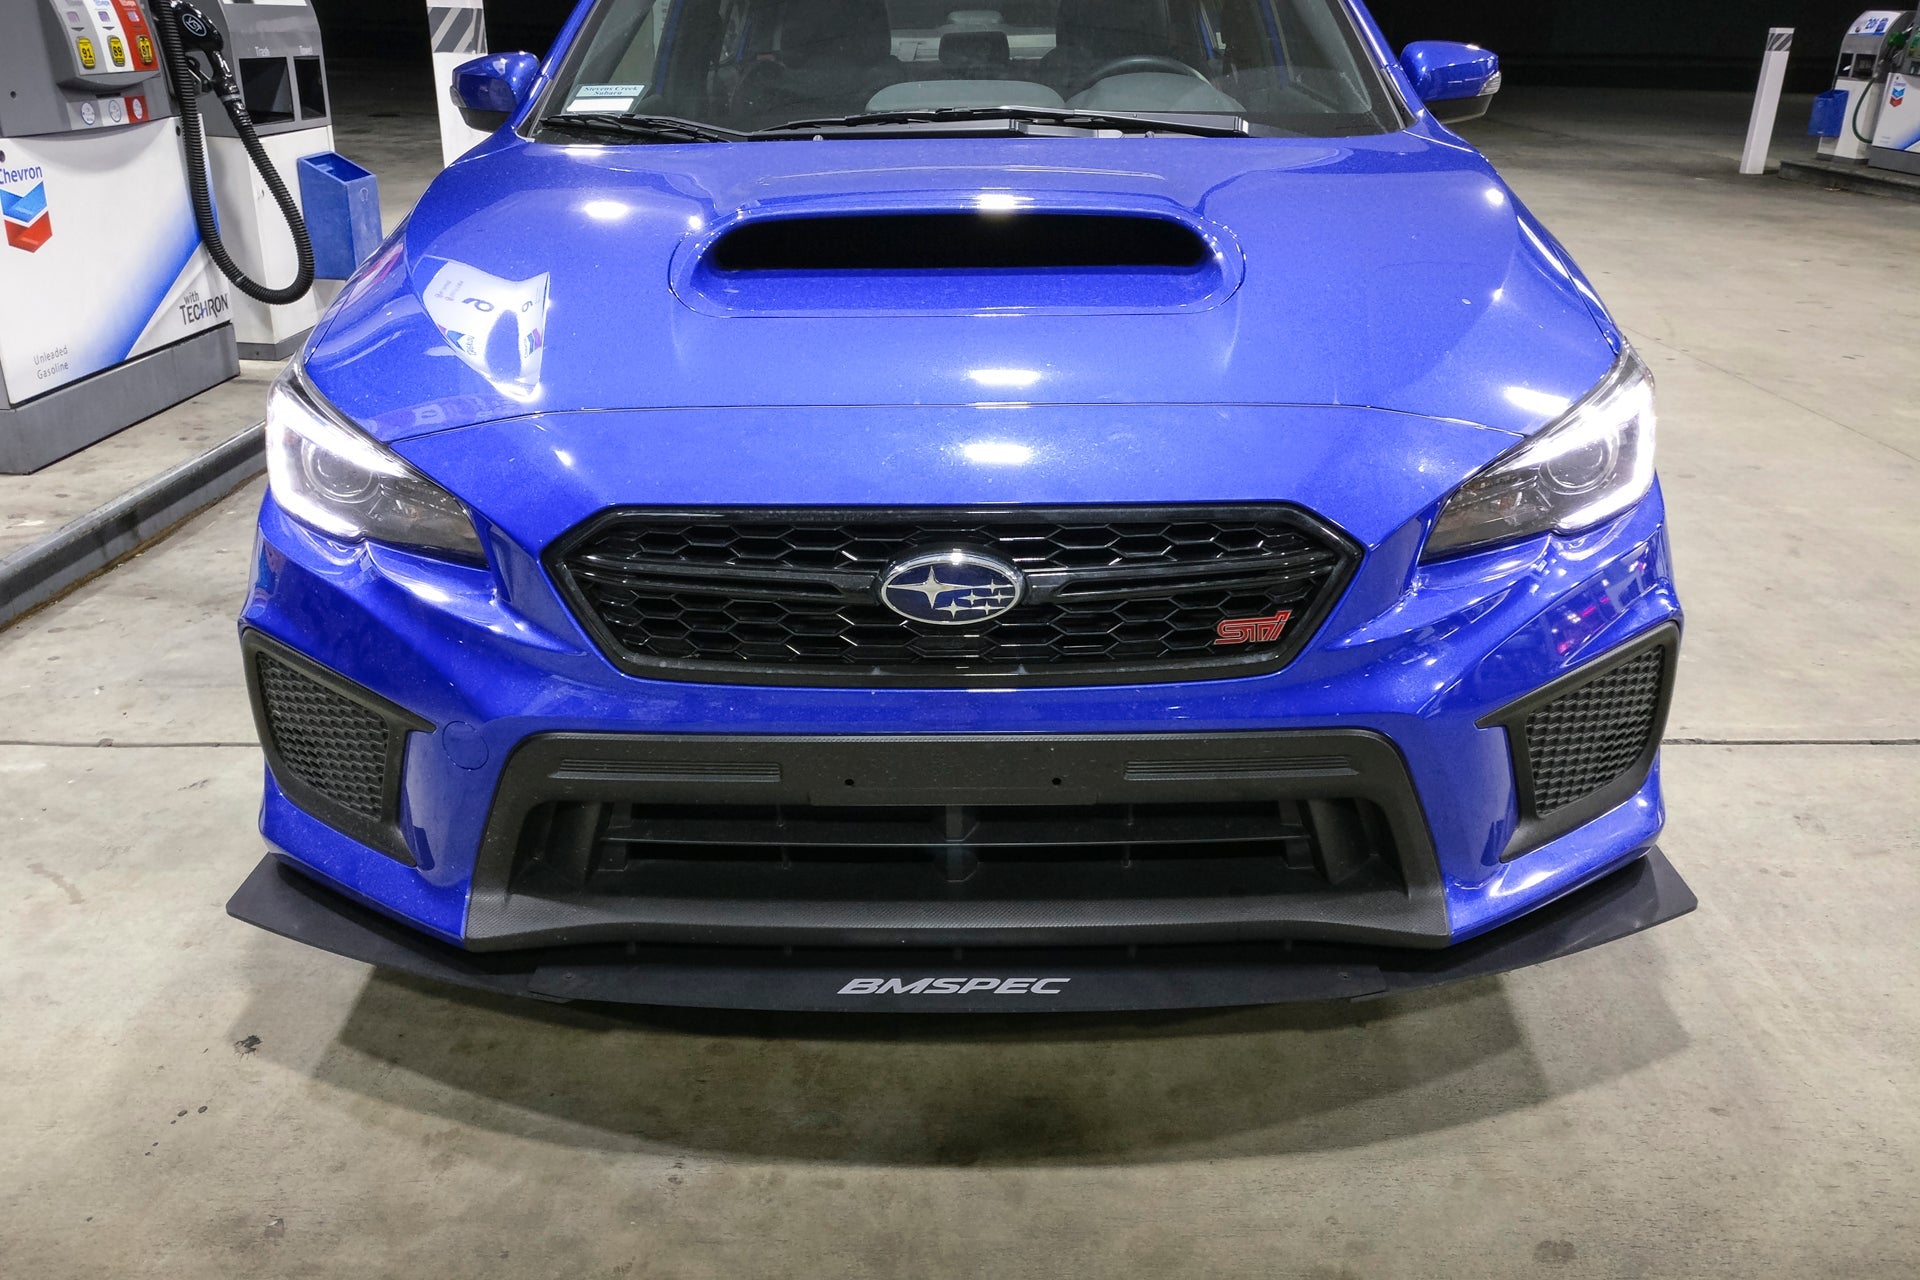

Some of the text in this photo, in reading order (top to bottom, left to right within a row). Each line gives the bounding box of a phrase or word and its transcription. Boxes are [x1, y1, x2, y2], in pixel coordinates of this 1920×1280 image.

[82, 48, 92, 58] 91
[183, 290, 200, 305] with
[179, 293, 229, 325] TECHRON
[33, 345, 68, 366] Unleaded
[37, 362, 69, 380] Gasoline
[837, 978, 1071, 994] BMSPEC
